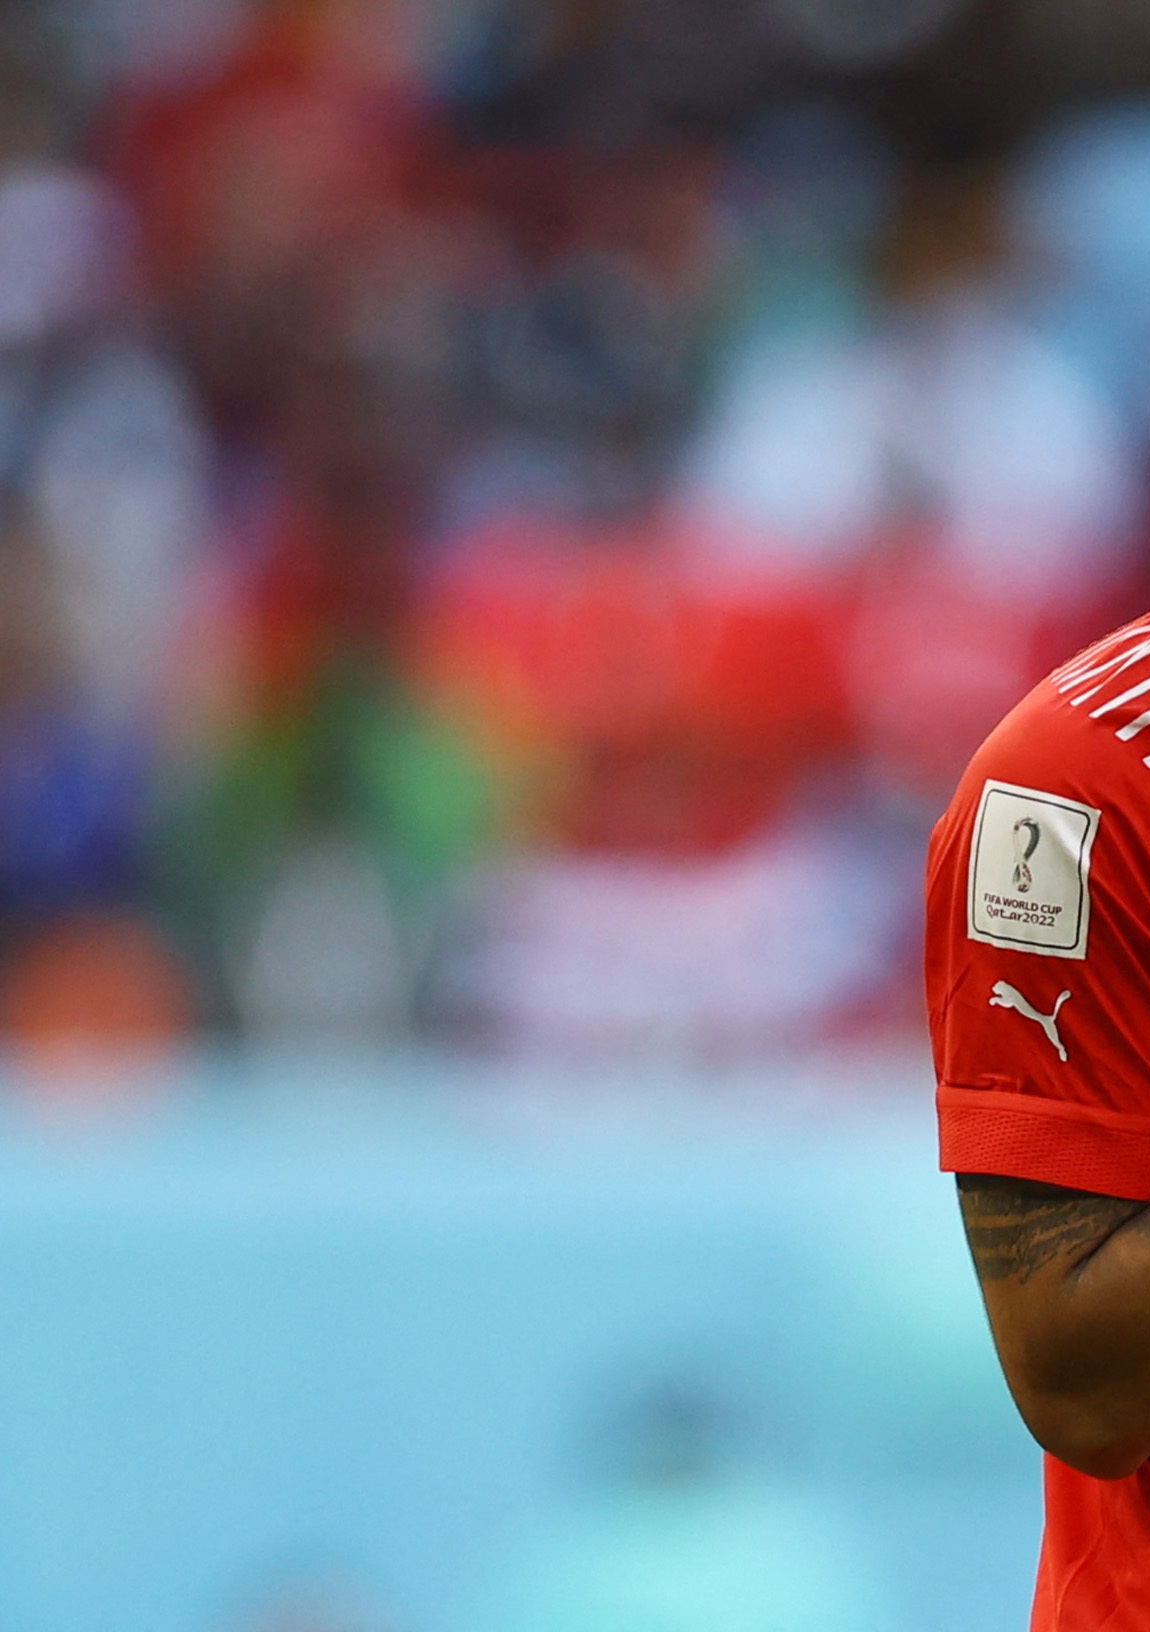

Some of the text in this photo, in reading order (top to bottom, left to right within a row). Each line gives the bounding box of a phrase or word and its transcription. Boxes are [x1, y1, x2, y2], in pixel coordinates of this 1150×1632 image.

[984, 892, 1063, 915] FIFA WORLD CUP
